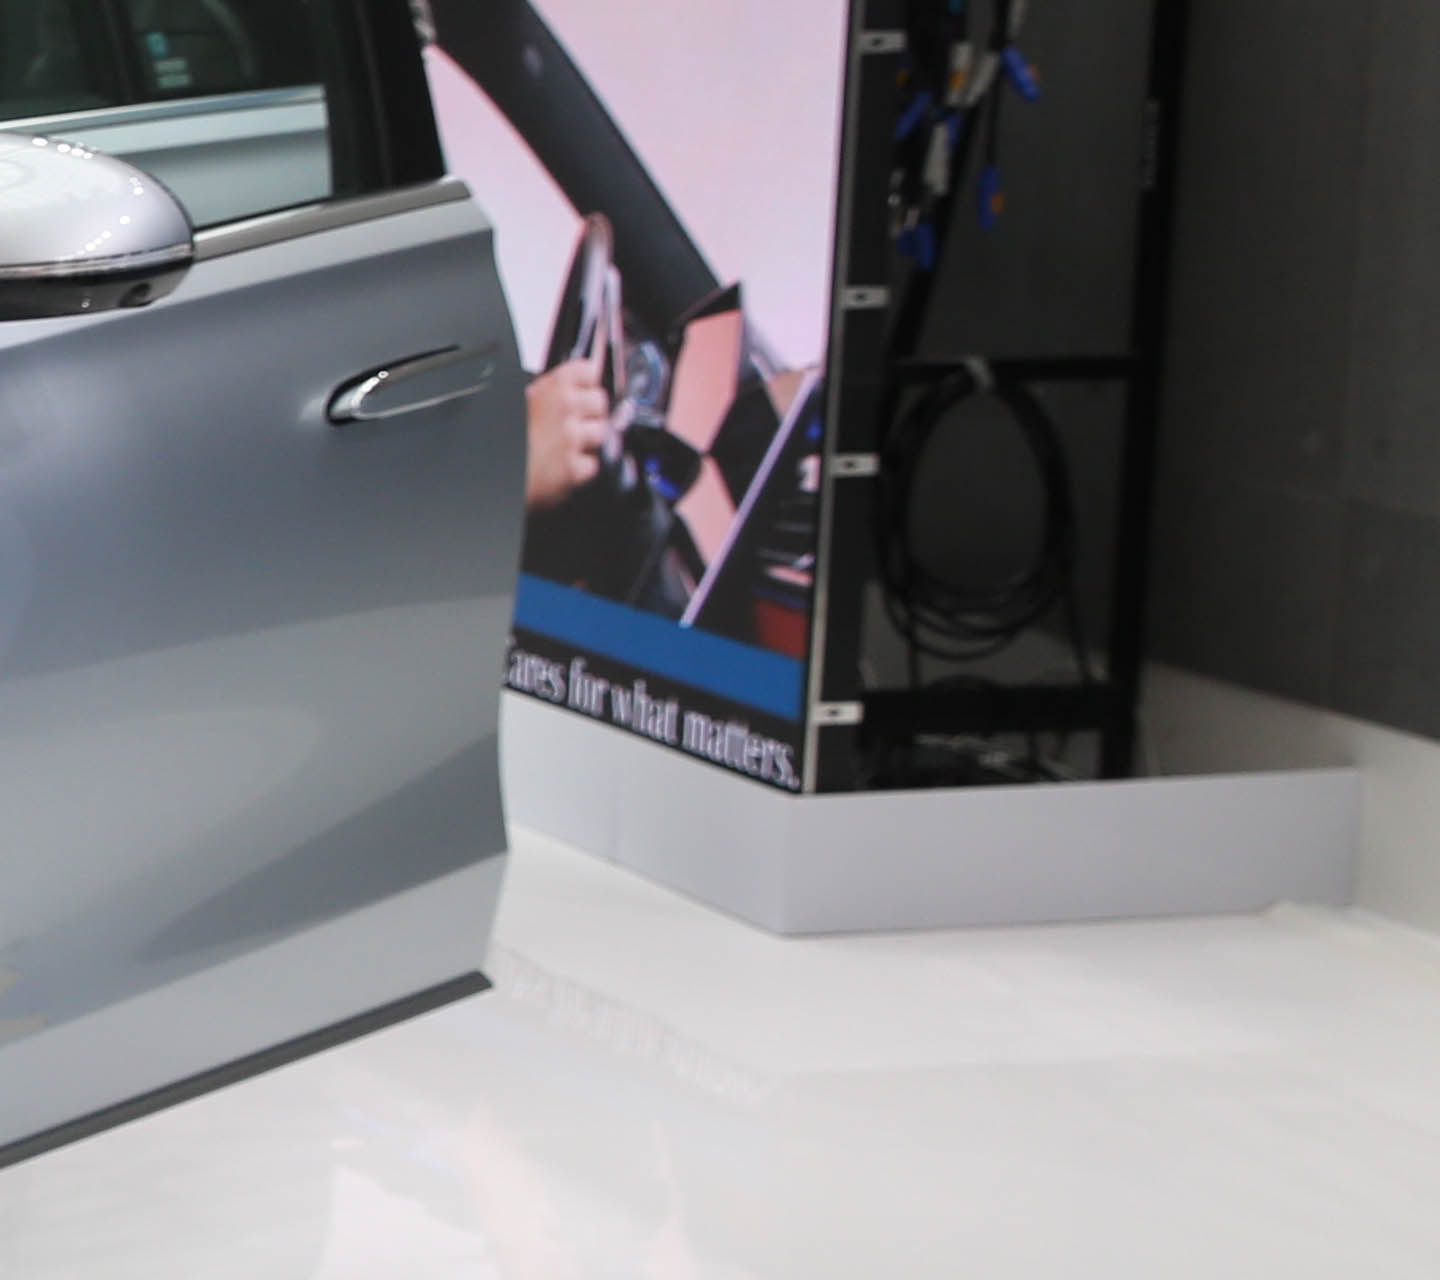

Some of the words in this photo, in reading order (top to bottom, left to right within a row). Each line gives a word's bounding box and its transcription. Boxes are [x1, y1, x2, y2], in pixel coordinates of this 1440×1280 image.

[568, 656, 610, 717] for
[611, 678, 679, 746] what
[684, 709, 800, 790] matters.
